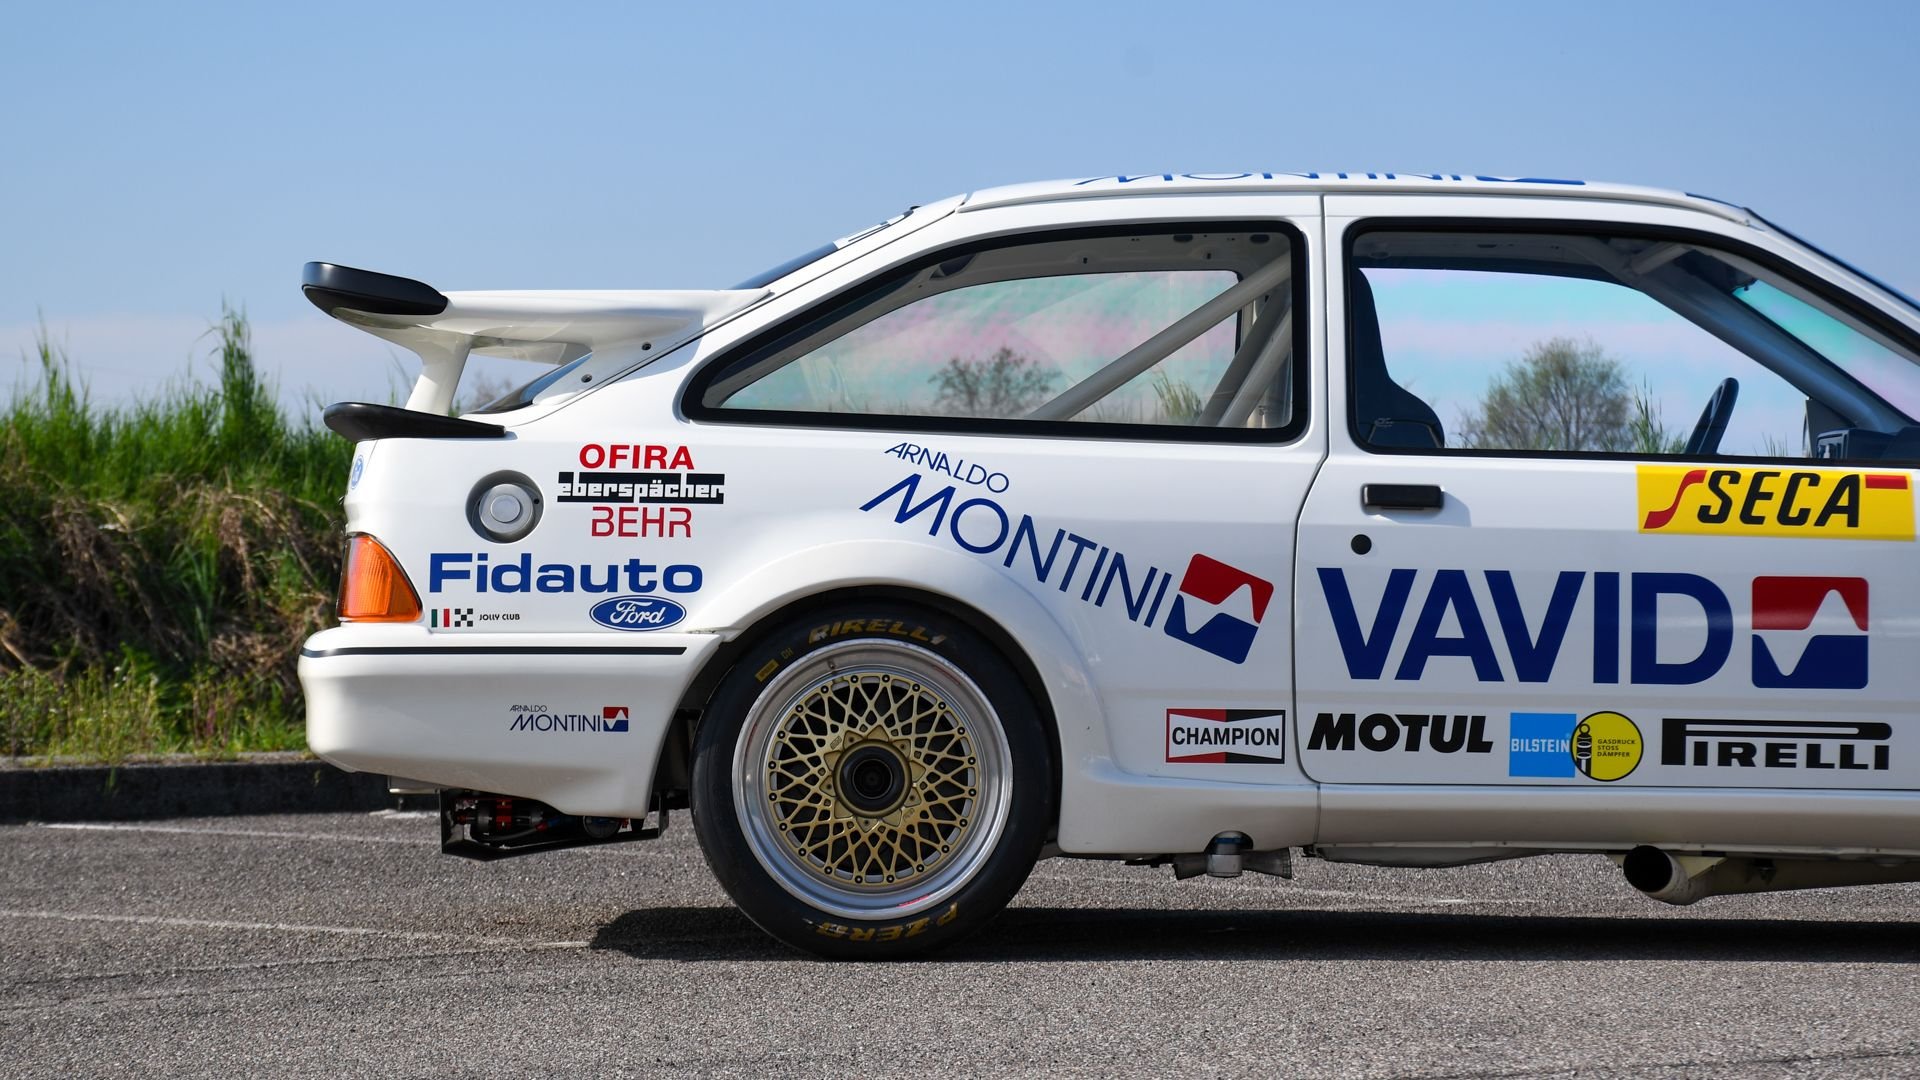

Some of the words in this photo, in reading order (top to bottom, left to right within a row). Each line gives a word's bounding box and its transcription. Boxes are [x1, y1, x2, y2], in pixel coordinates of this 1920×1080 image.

[579, 442, 695, 470] OFIRA
[884, 441, 1010, 494] ARNALDO
[557, 471, 725, 505] eberspächer
[1697, 470, 1861, 528] SECA
[591, 506, 693, 539] BEHR
[859, 473, 1172, 628] MONTINI
[429, 552, 704, 594] Fidauto
[502, 613, 521, 621] CLUB
[609, 600, 667, 624] Ford
[1316, 567, 1735, 686] VAVID
[808, 618, 947, 647] PIRELLI
[509, 704, 548, 713] ARNALDO
[509, 714, 601, 733] MONTINI
[1171, 726, 1280, 746] CHAMPION
[1307, 712, 1494, 754] MOTUL
[1510, 737, 1571, 753] BILSTEIN
[1661, 718, 1893, 771] PIRELLI
